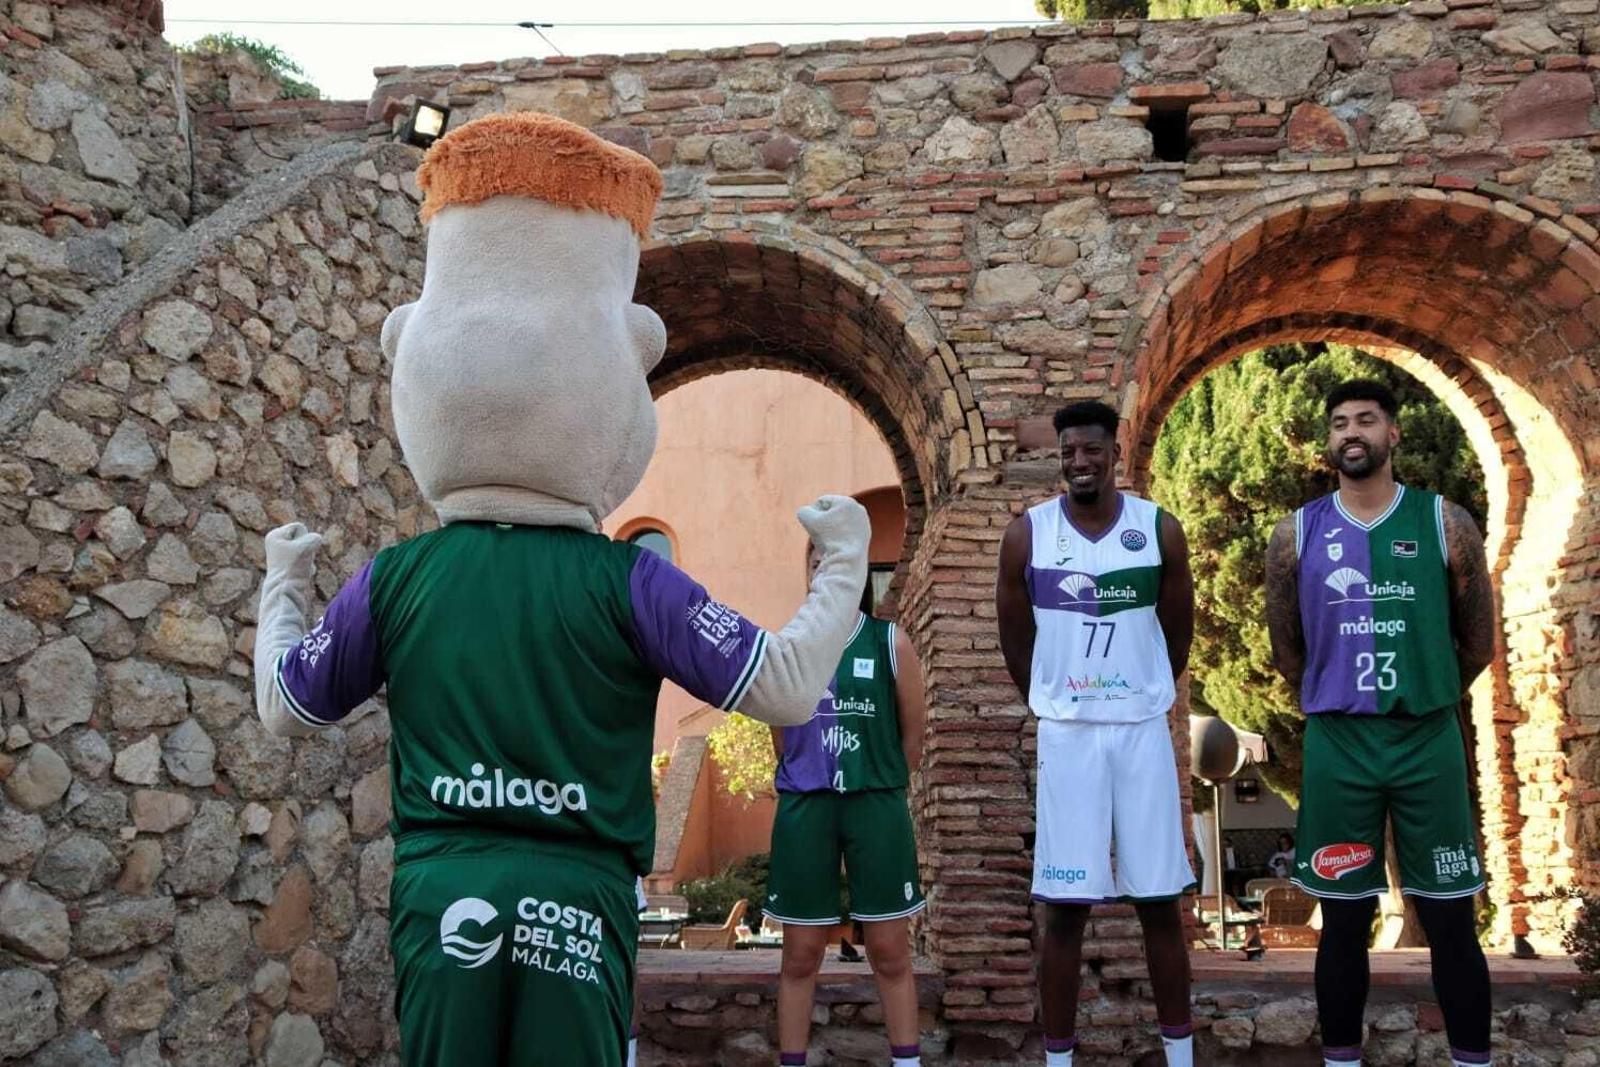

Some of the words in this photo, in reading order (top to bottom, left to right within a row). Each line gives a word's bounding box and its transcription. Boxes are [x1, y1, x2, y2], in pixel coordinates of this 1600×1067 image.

[1093, 585, 1137, 600] Unicaja
[1364, 581, 1416, 598] Unicaja
[1082, 621, 1116, 658] 77
[1340, 616, 1406, 637] málaga
[1356, 652, 1397, 691] 23
[831, 697, 876, 714] Unicaja
[821, 725, 861, 757] Mijas
[430, 762, 588, 815] málaga
[516, 896, 603, 942] COSTA
[513, 924, 560, 950] DEL
[564, 934, 603, 964] SOL
[511, 946, 600, 985] MÁLAGA
